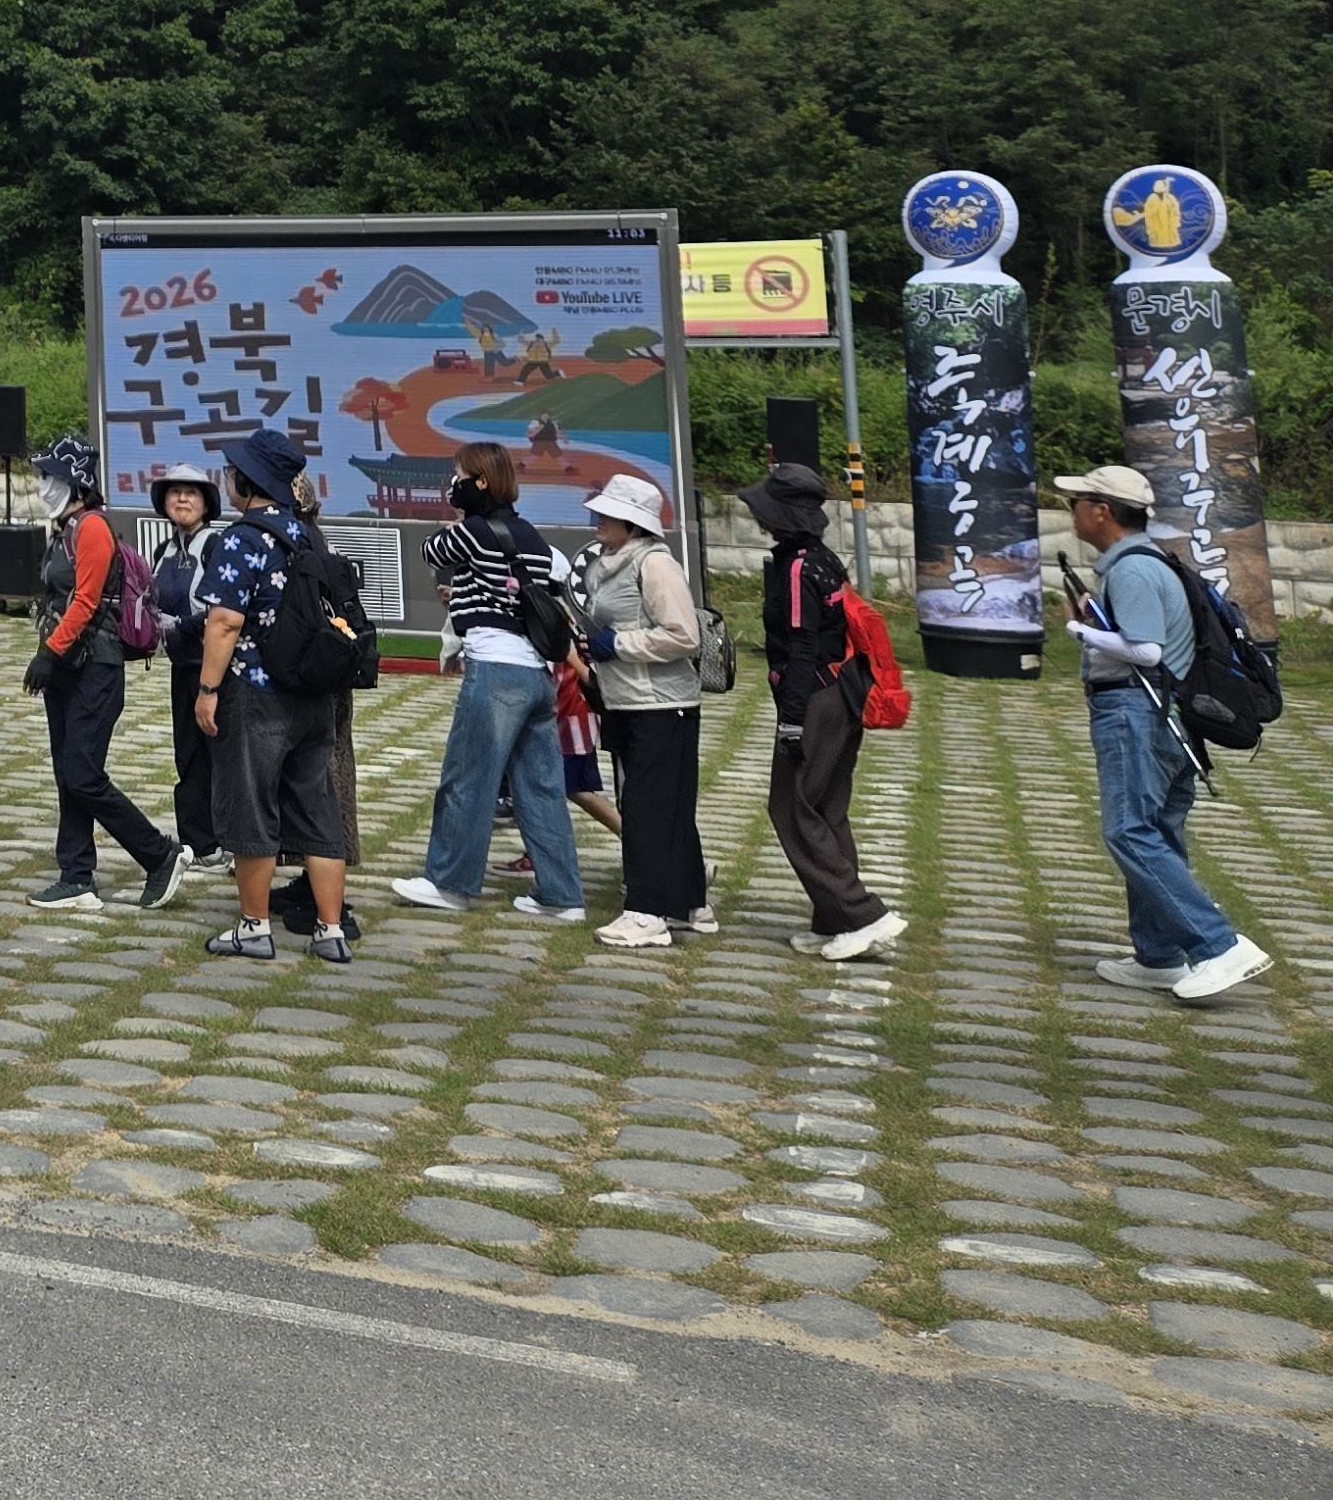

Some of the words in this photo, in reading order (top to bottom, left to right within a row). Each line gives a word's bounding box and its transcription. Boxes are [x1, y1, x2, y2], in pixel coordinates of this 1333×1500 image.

[118, 267, 218, 318] 2026
[562, 291, 610, 304] YouTube
[612, 291, 643, 304] LIVE
[910, 287, 1004, 327] 영주시
[1121, 286, 1223, 336] 문경시
[124, 301, 292, 387] 경북
[105, 375, 323, 456] 구곡길
[927, 344, 994, 613] 죽계구곡
[1142, 346, 1230, 597] 선유구곡
